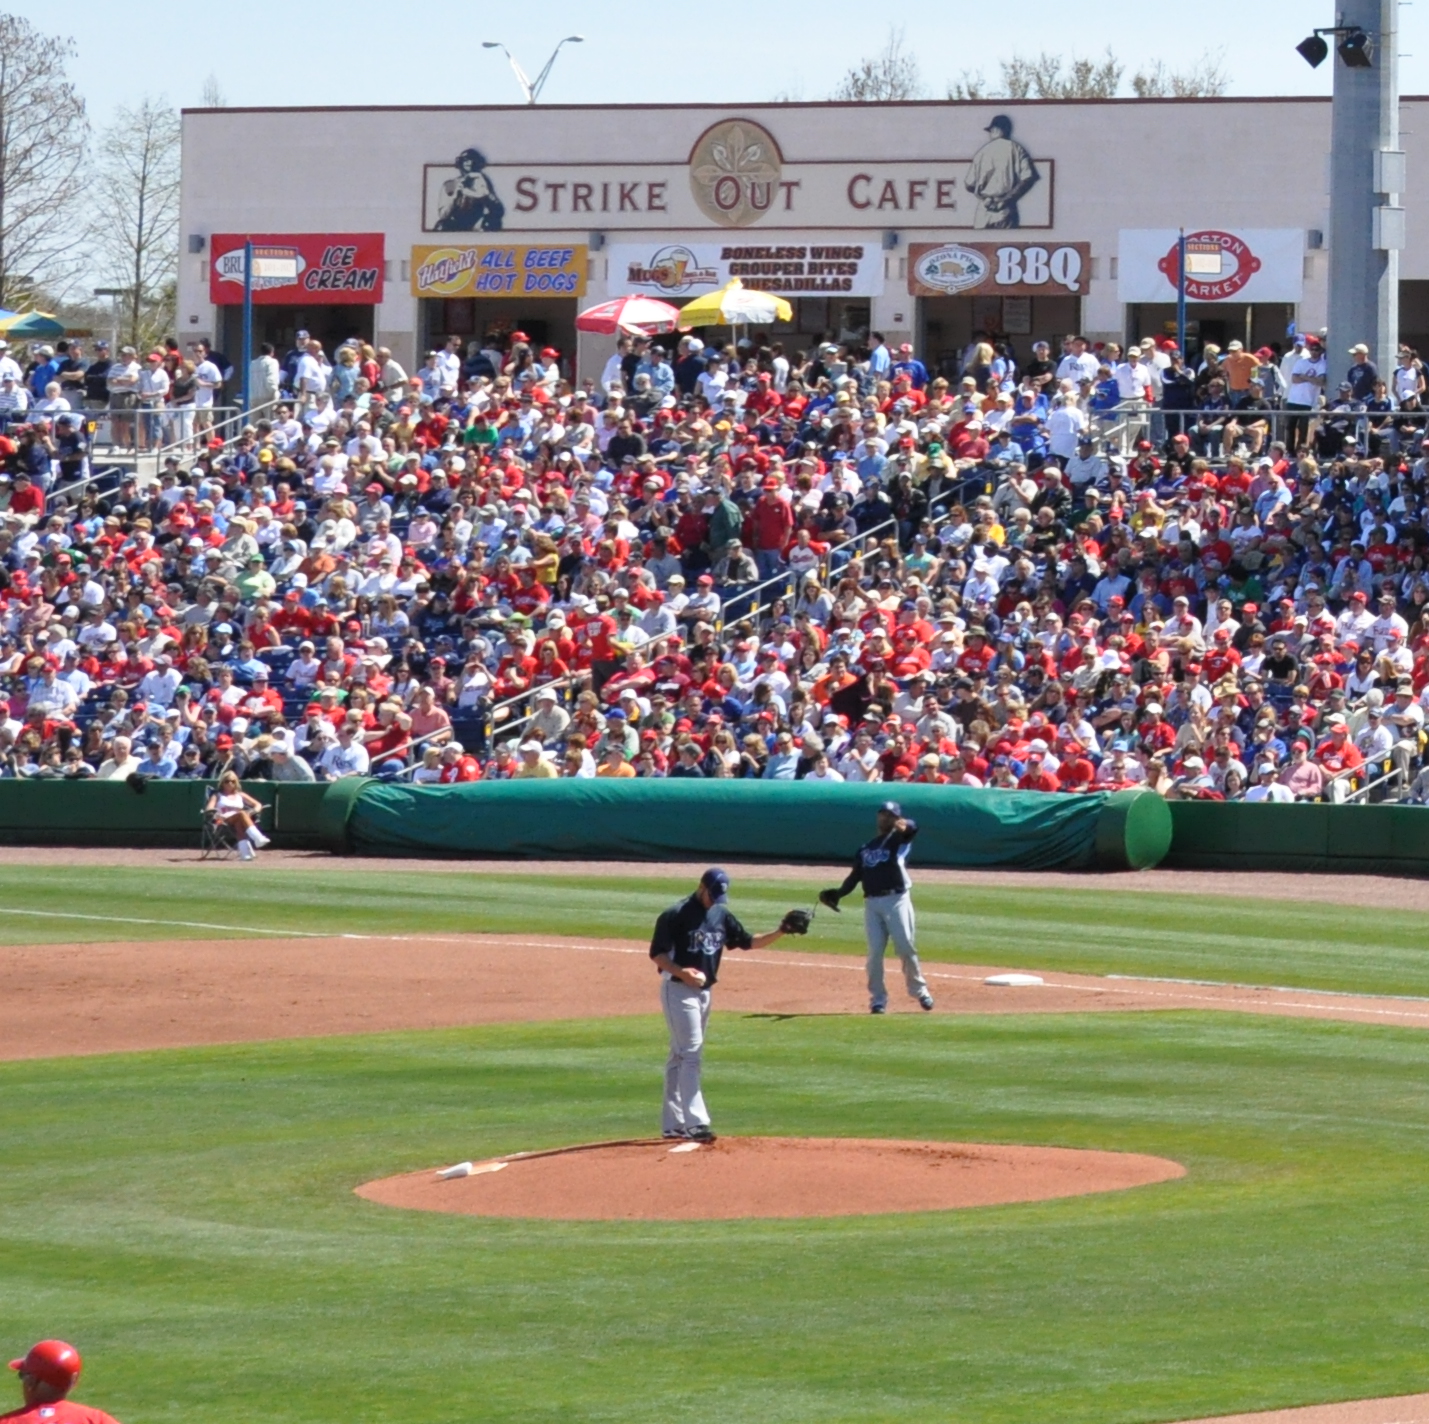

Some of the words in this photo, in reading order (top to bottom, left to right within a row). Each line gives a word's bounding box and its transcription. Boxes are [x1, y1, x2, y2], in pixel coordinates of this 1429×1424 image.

[514, 176, 668, 212] STRIKE
[712, 175, 801, 211] OUT
[847, 173, 957, 210] CAFE
[254, 248, 296, 257] SECTIONS
[321, 246, 357, 267] ICE
[721, 246, 807, 260] BONELESS
[810, 246, 864, 260] WINGS
[1187, 243, 1219, 251] SECTIONS
[417, 249, 477, 289] Hatfield
[480, 249, 515, 269] ALL
[524, 249, 574, 269] BEEF
[728, 261, 804, 276] GROUPER
[807, 261, 858, 276] BITES
[995, 246, 1081, 292] BBQ
[304, 268, 378, 290] CREAM
[476, 273, 518, 291] HOT
[524, 273, 579, 292] DOGS
[1184, 275, 1242, 296] ARKET
